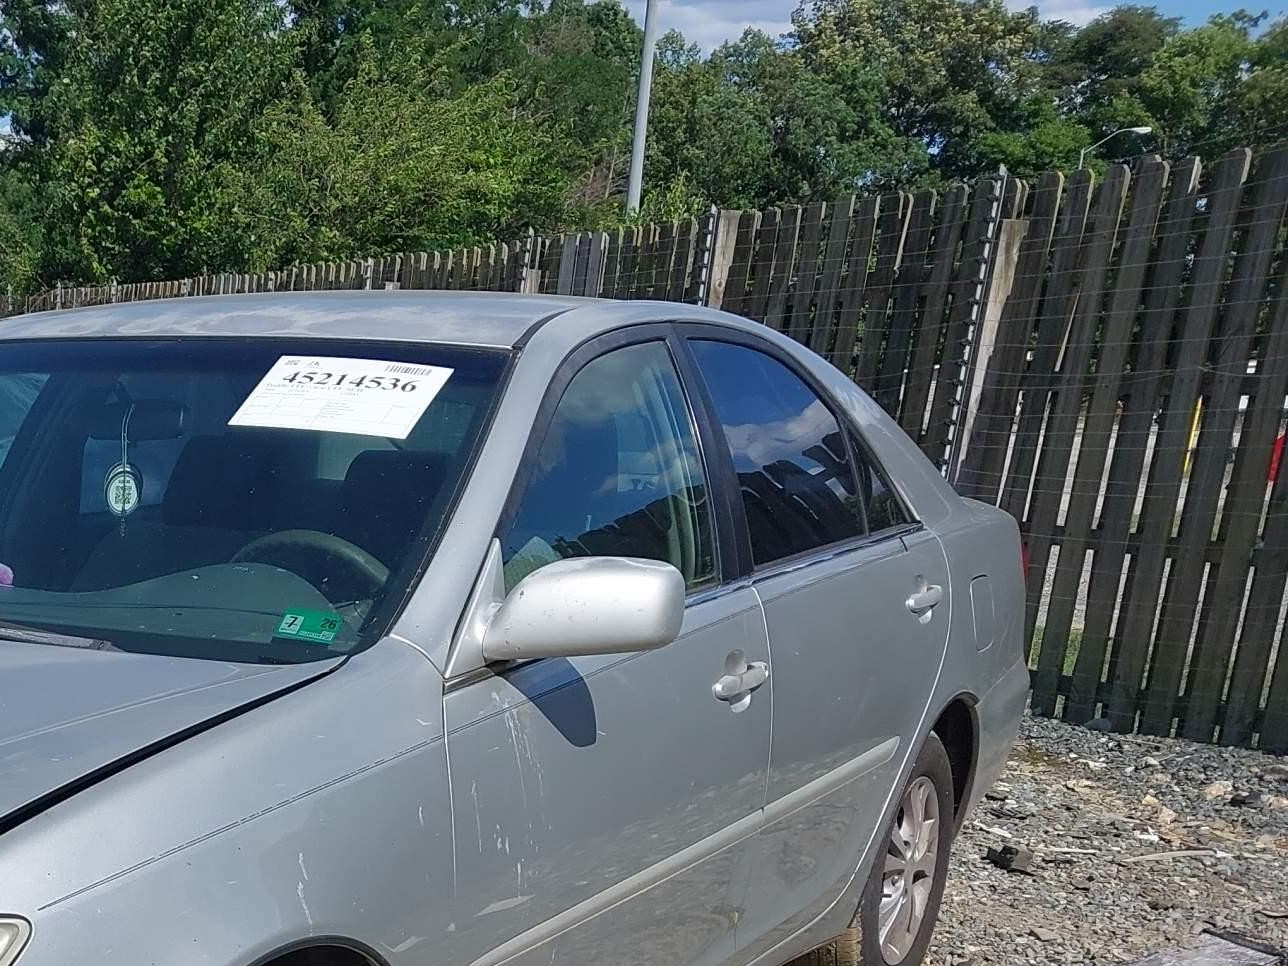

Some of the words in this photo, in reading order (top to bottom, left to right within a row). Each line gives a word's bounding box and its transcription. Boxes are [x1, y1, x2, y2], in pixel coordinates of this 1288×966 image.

[282, 371, 419, 392] 45214536
[287, 616, 298, 628] 7
[320, 618, 337, 629] 26
